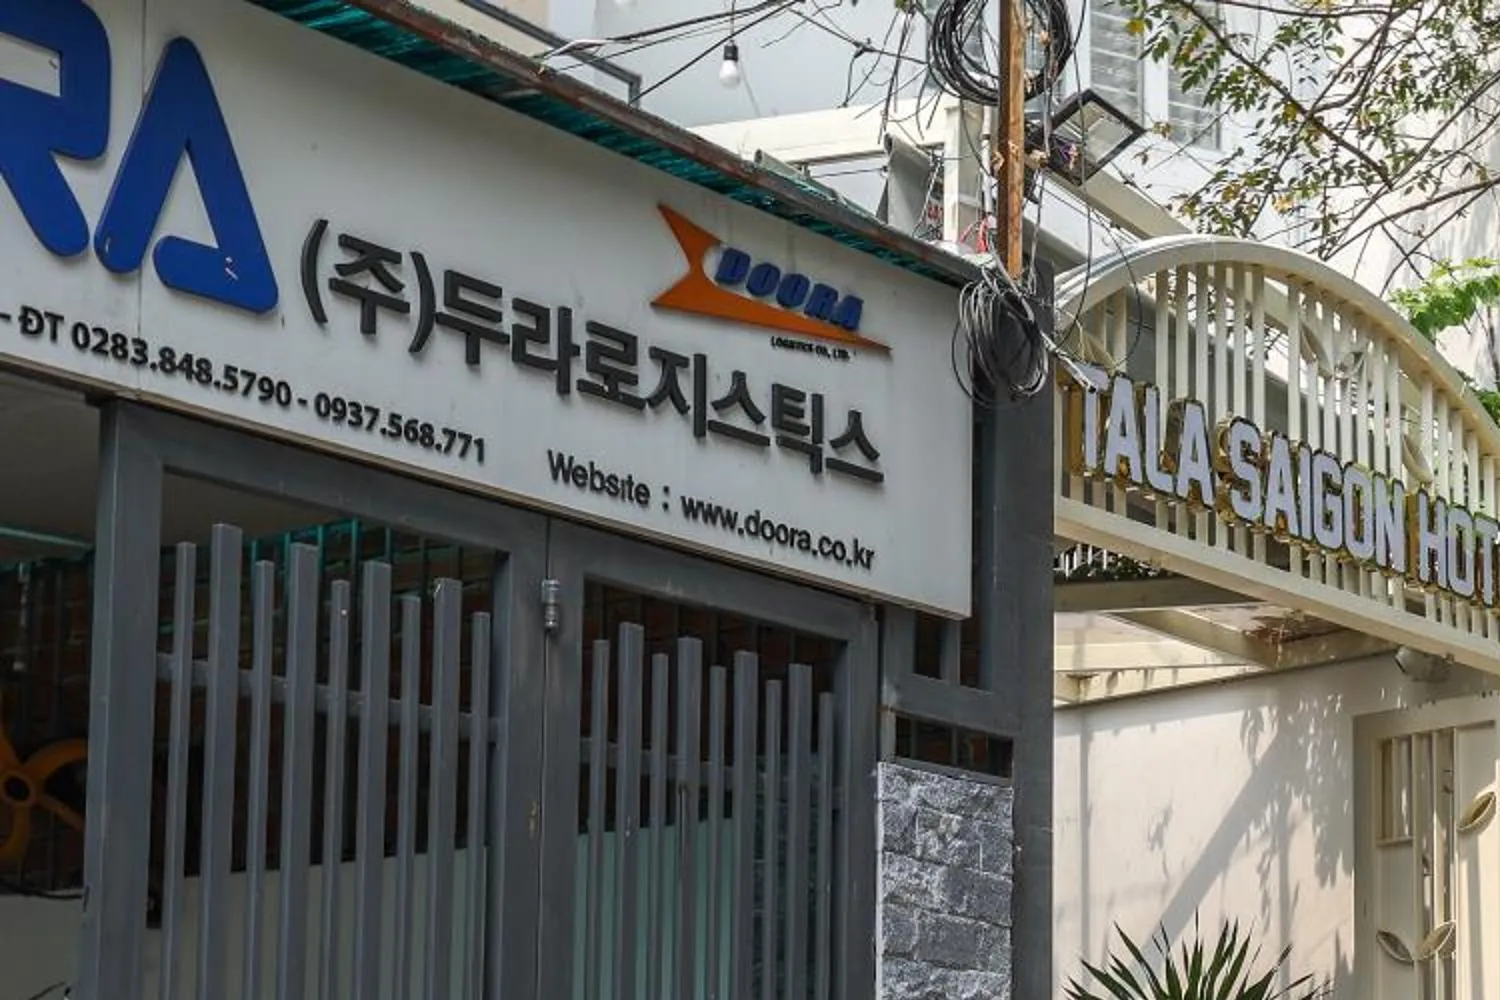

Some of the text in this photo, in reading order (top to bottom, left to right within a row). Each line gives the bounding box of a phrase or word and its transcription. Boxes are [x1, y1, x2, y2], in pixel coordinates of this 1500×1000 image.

[301, 219, 885, 484] (주)두라로지스틱스
[715, 248, 865, 331] DOORA
[18, 305, 65, 344] ĐT
[71, 321, 292, 408] 0283.848.5790
[313, 392, 486, 464] 0937.568.771
[547, 449, 651, 507] Website
[680, 495, 876, 572] www.doora.co.kr
[1065, 360, 1216, 508] TALA
[1228, 415, 1407, 575] SAIGON
